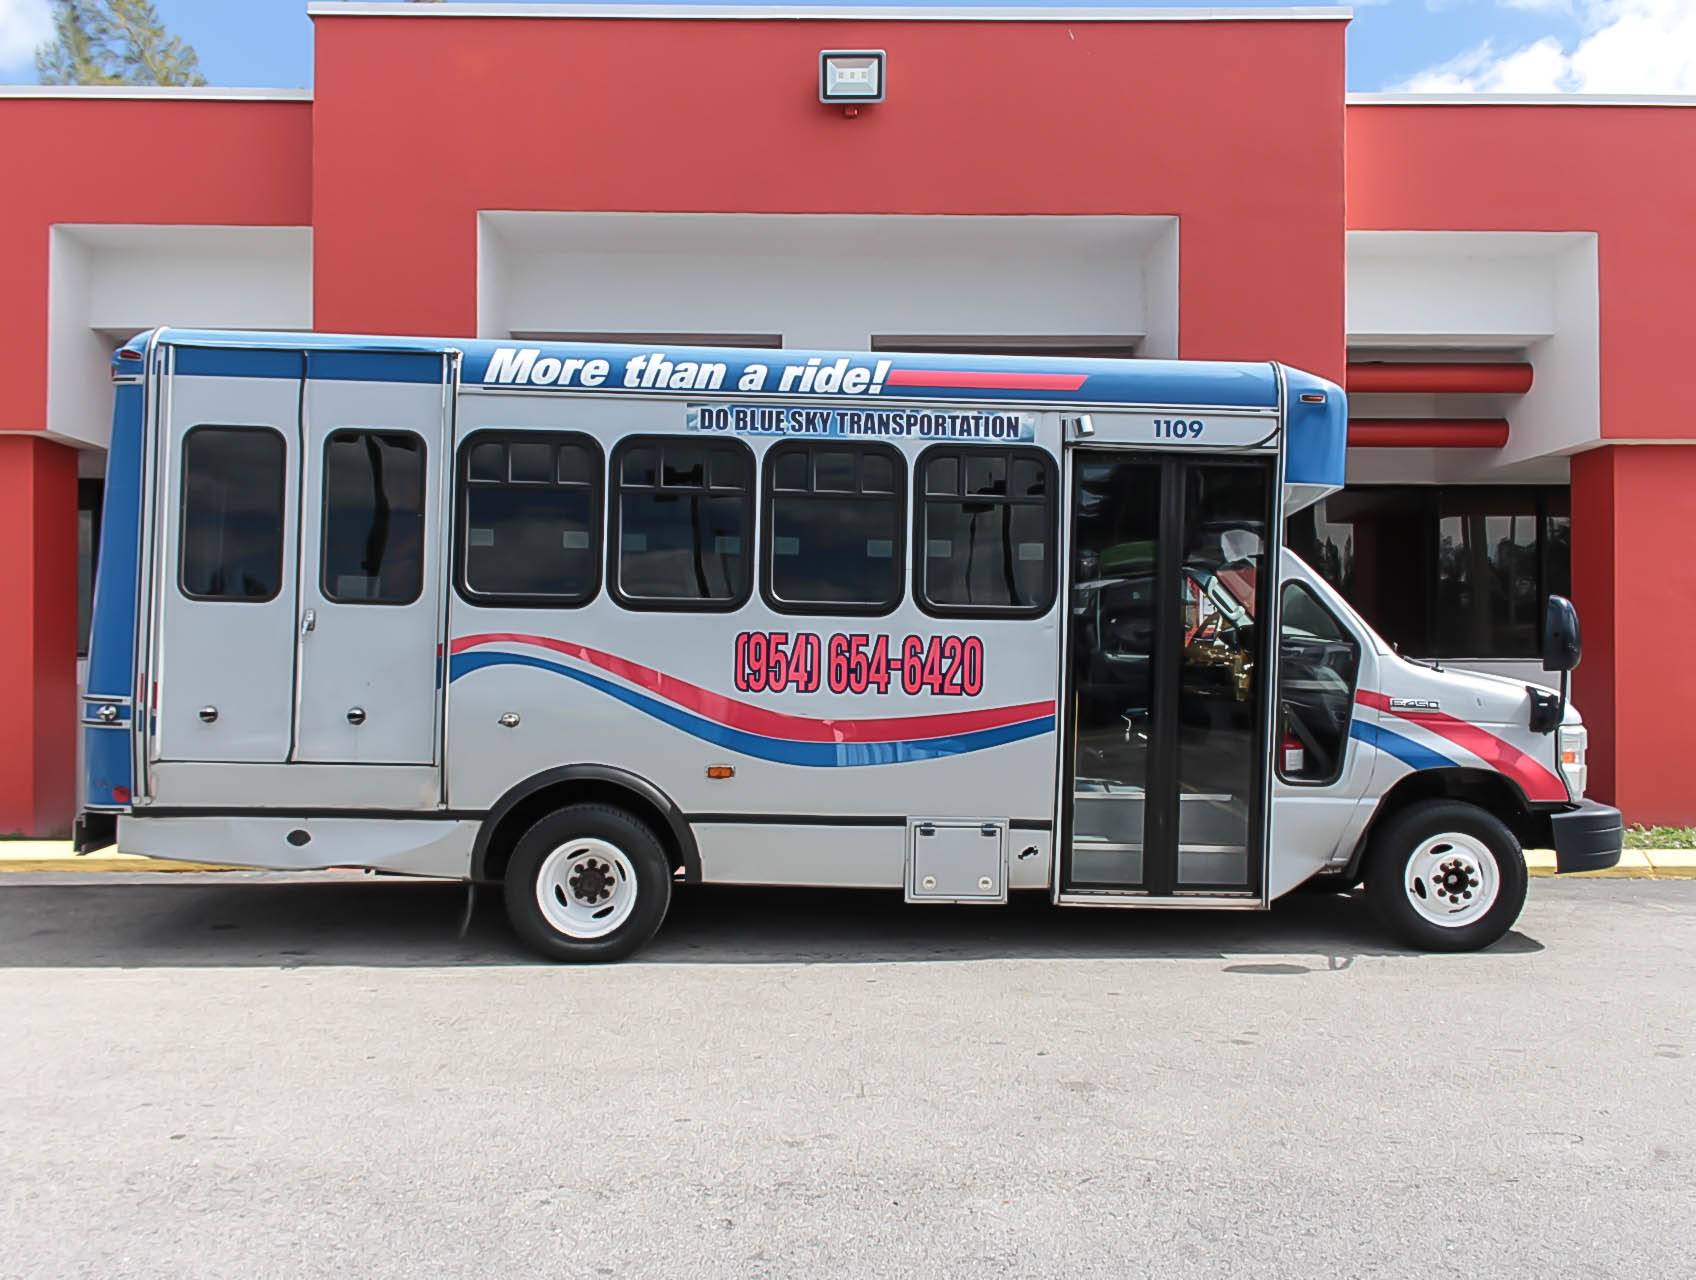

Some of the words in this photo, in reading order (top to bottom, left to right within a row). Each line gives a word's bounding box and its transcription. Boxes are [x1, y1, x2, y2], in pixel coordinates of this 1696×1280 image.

[483, 348, 610, 387] More
[623, 353, 728, 391] than
[738, 363, 768, 392] a
[778, 357, 893, 395] ride!
[700, 408, 729, 431] DO
[735, 408, 785, 433] BLUE
[790, 410, 832, 434] SKY
[836, 411, 1020, 438] TRANSPORTATION
[1153, 419, 1204, 439] 1109
[734, 631, 821, 693] (954)
[827, 633, 984, 696] 654-6420
